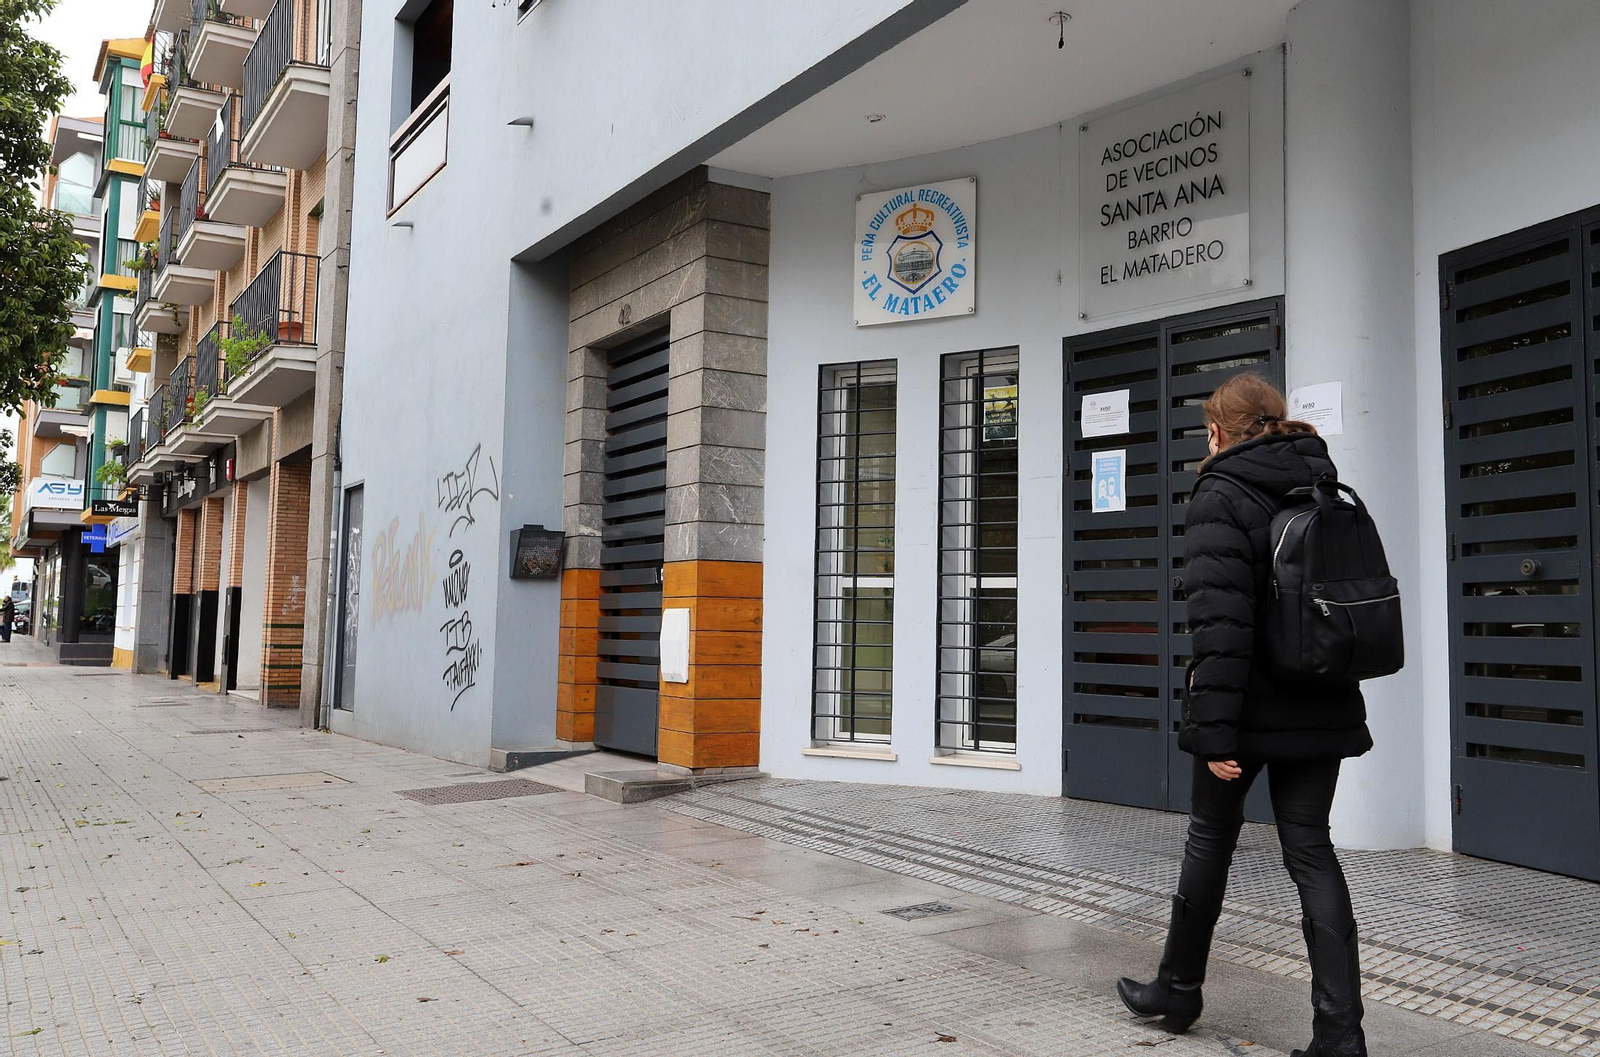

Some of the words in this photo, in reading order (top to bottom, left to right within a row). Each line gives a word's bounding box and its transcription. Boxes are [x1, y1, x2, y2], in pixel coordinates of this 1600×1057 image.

[1101, 111, 1222, 166] ASOCIACIÓN
[1106, 169, 1128, 192] DE
[1133, 142, 1218, 183] VECINOS
[861, 233, 877, 262] PEÑA
[869, 190, 915, 231] CULTURAL
[918, 189, 969, 249] RECREATIVISTA
[1100, 190, 1167, 227] SANTA
[1174, 174, 1225, 208] ANA
[1128, 216, 1193, 249] BARRIO
[1100, 265, 1117, 285] EL
[1123, 240, 1224, 280] MATADERO
[861, 273, 882, 301] EL
[883, 263, 967, 316] MATAERO
[94, 504, 108, 512] Las
